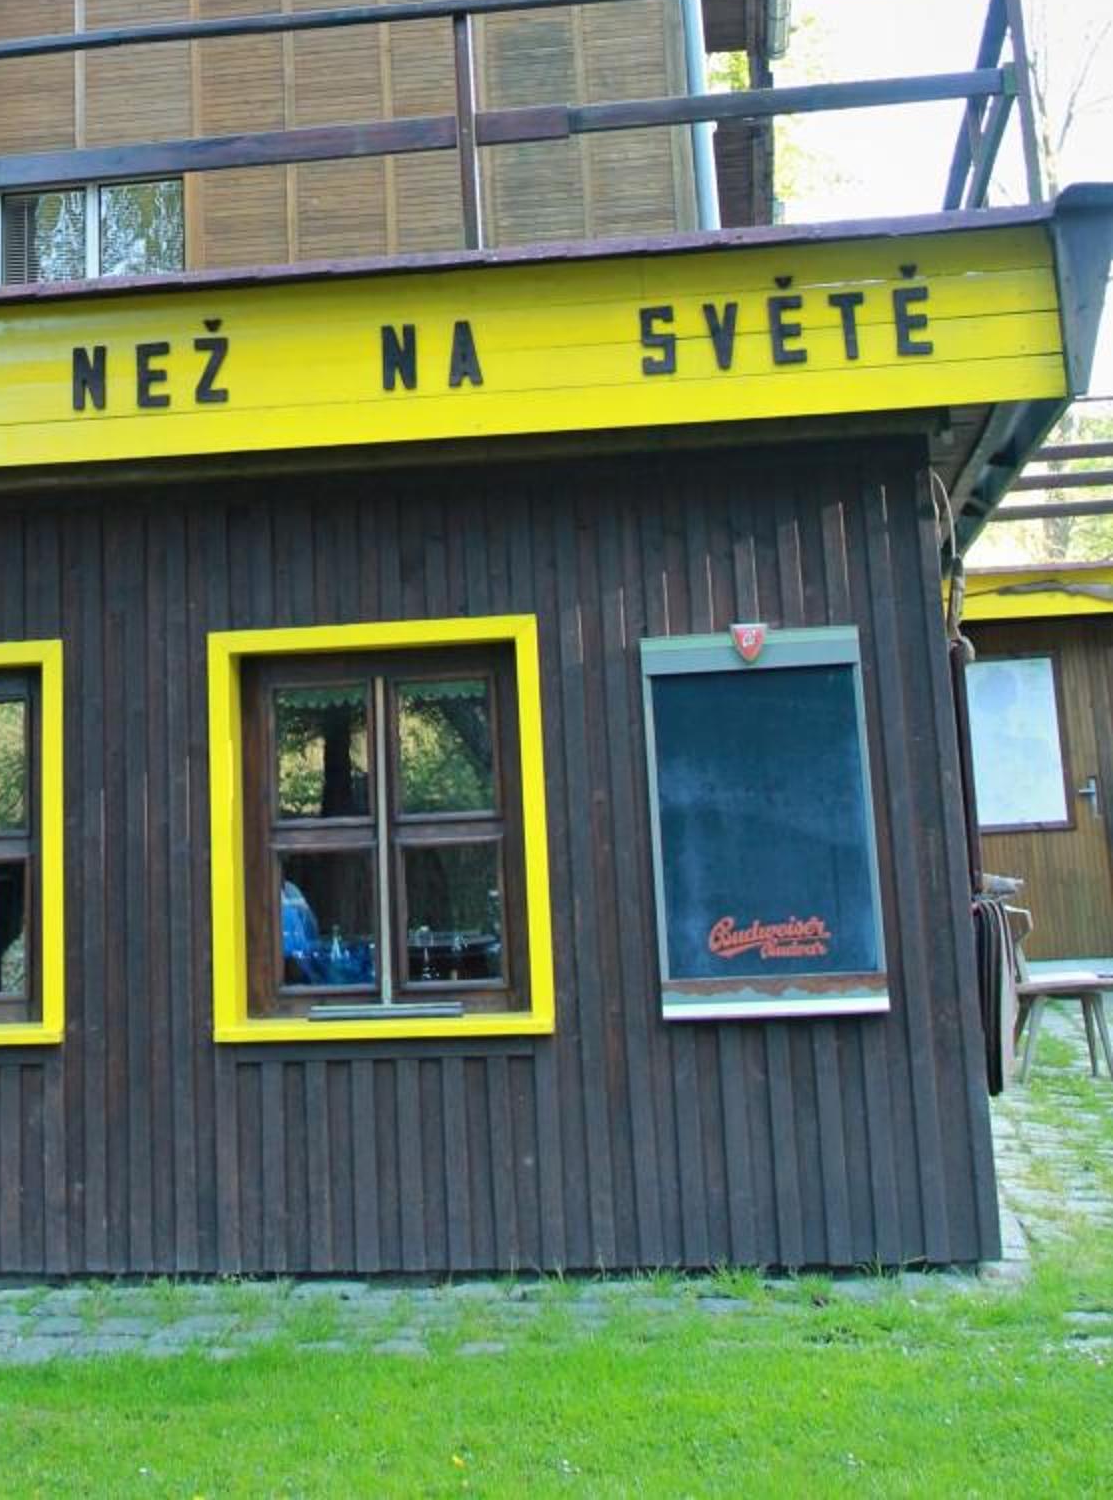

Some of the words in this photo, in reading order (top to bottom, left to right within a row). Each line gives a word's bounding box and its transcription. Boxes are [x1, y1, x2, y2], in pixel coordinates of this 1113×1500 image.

[72, 318, 229, 411] NEŽ
[381, 320, 483, 391] NA
[639, 263, 933, 376] SVĚTĚ
